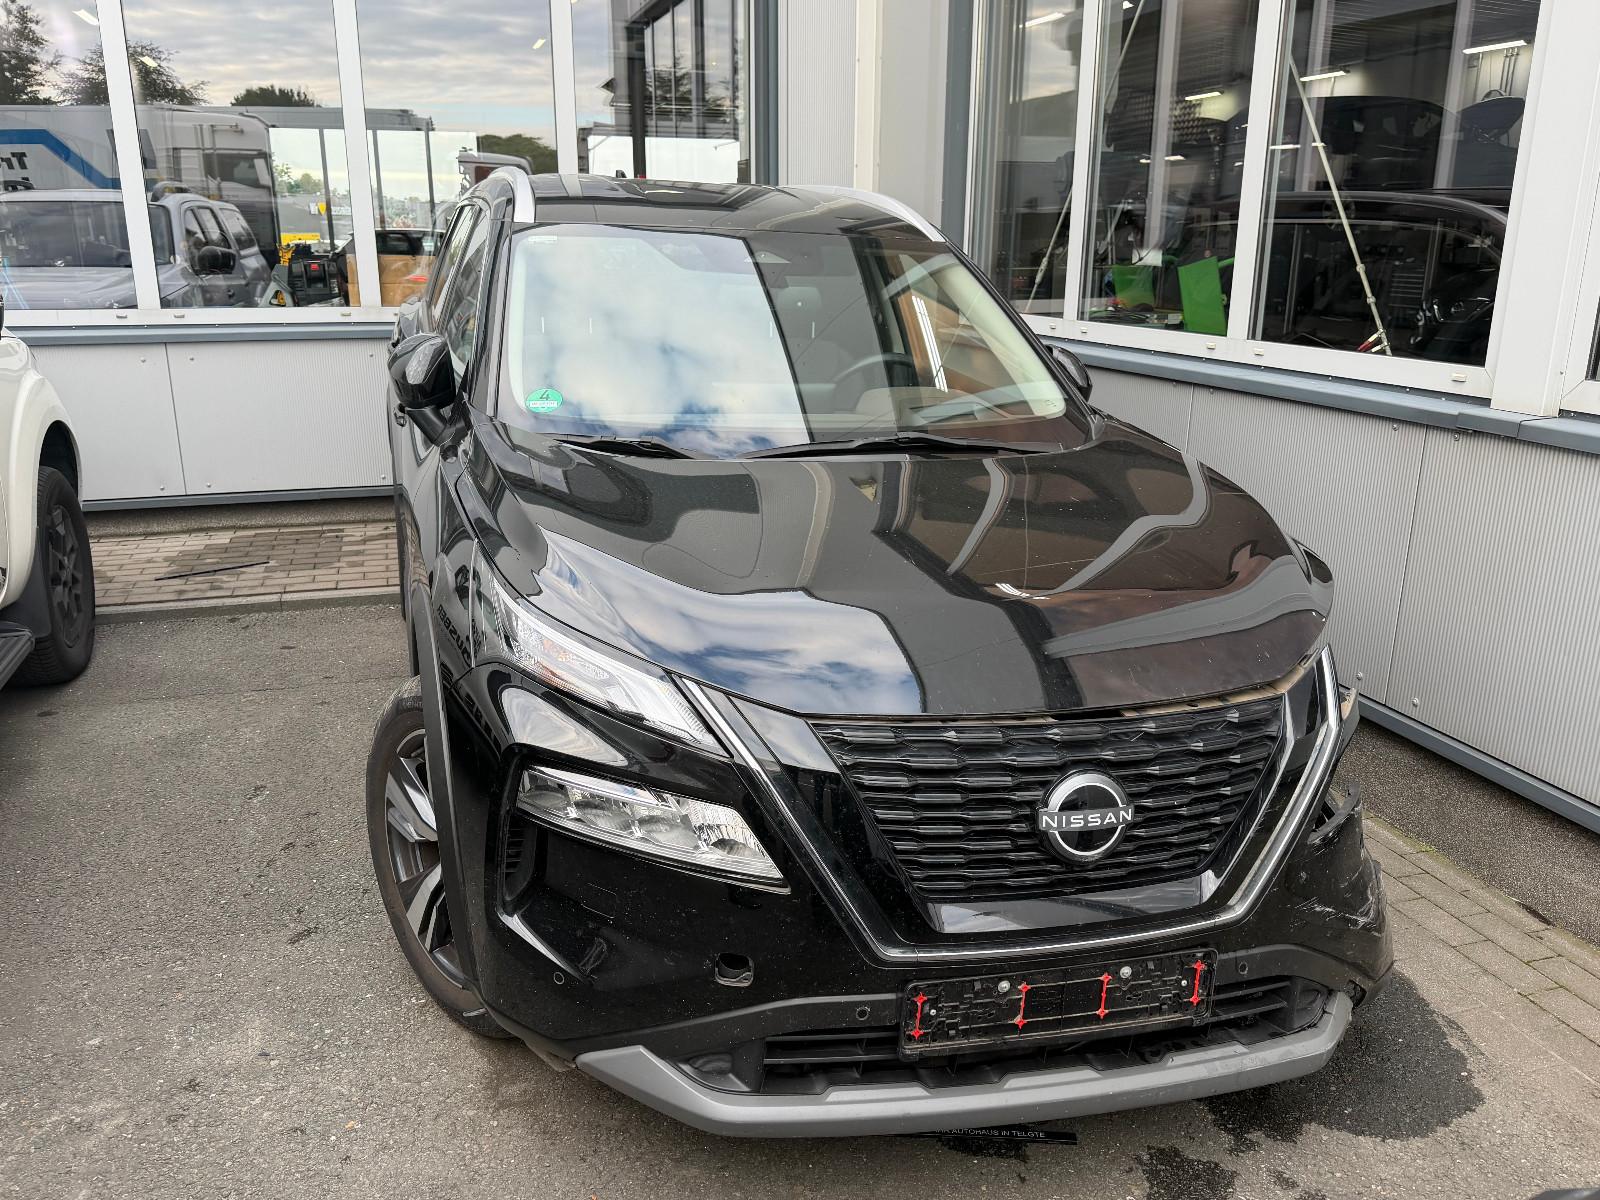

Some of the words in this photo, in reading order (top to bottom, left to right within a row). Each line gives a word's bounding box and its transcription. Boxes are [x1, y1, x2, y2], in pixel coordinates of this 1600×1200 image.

[539, 389, 551, 401] 4
[1041, 808, 1133, 829] NISSAN
[951, 1128, 999, 1136] AUTOHAUS
[1011, 1130, 1046, 1138] TELGTE
